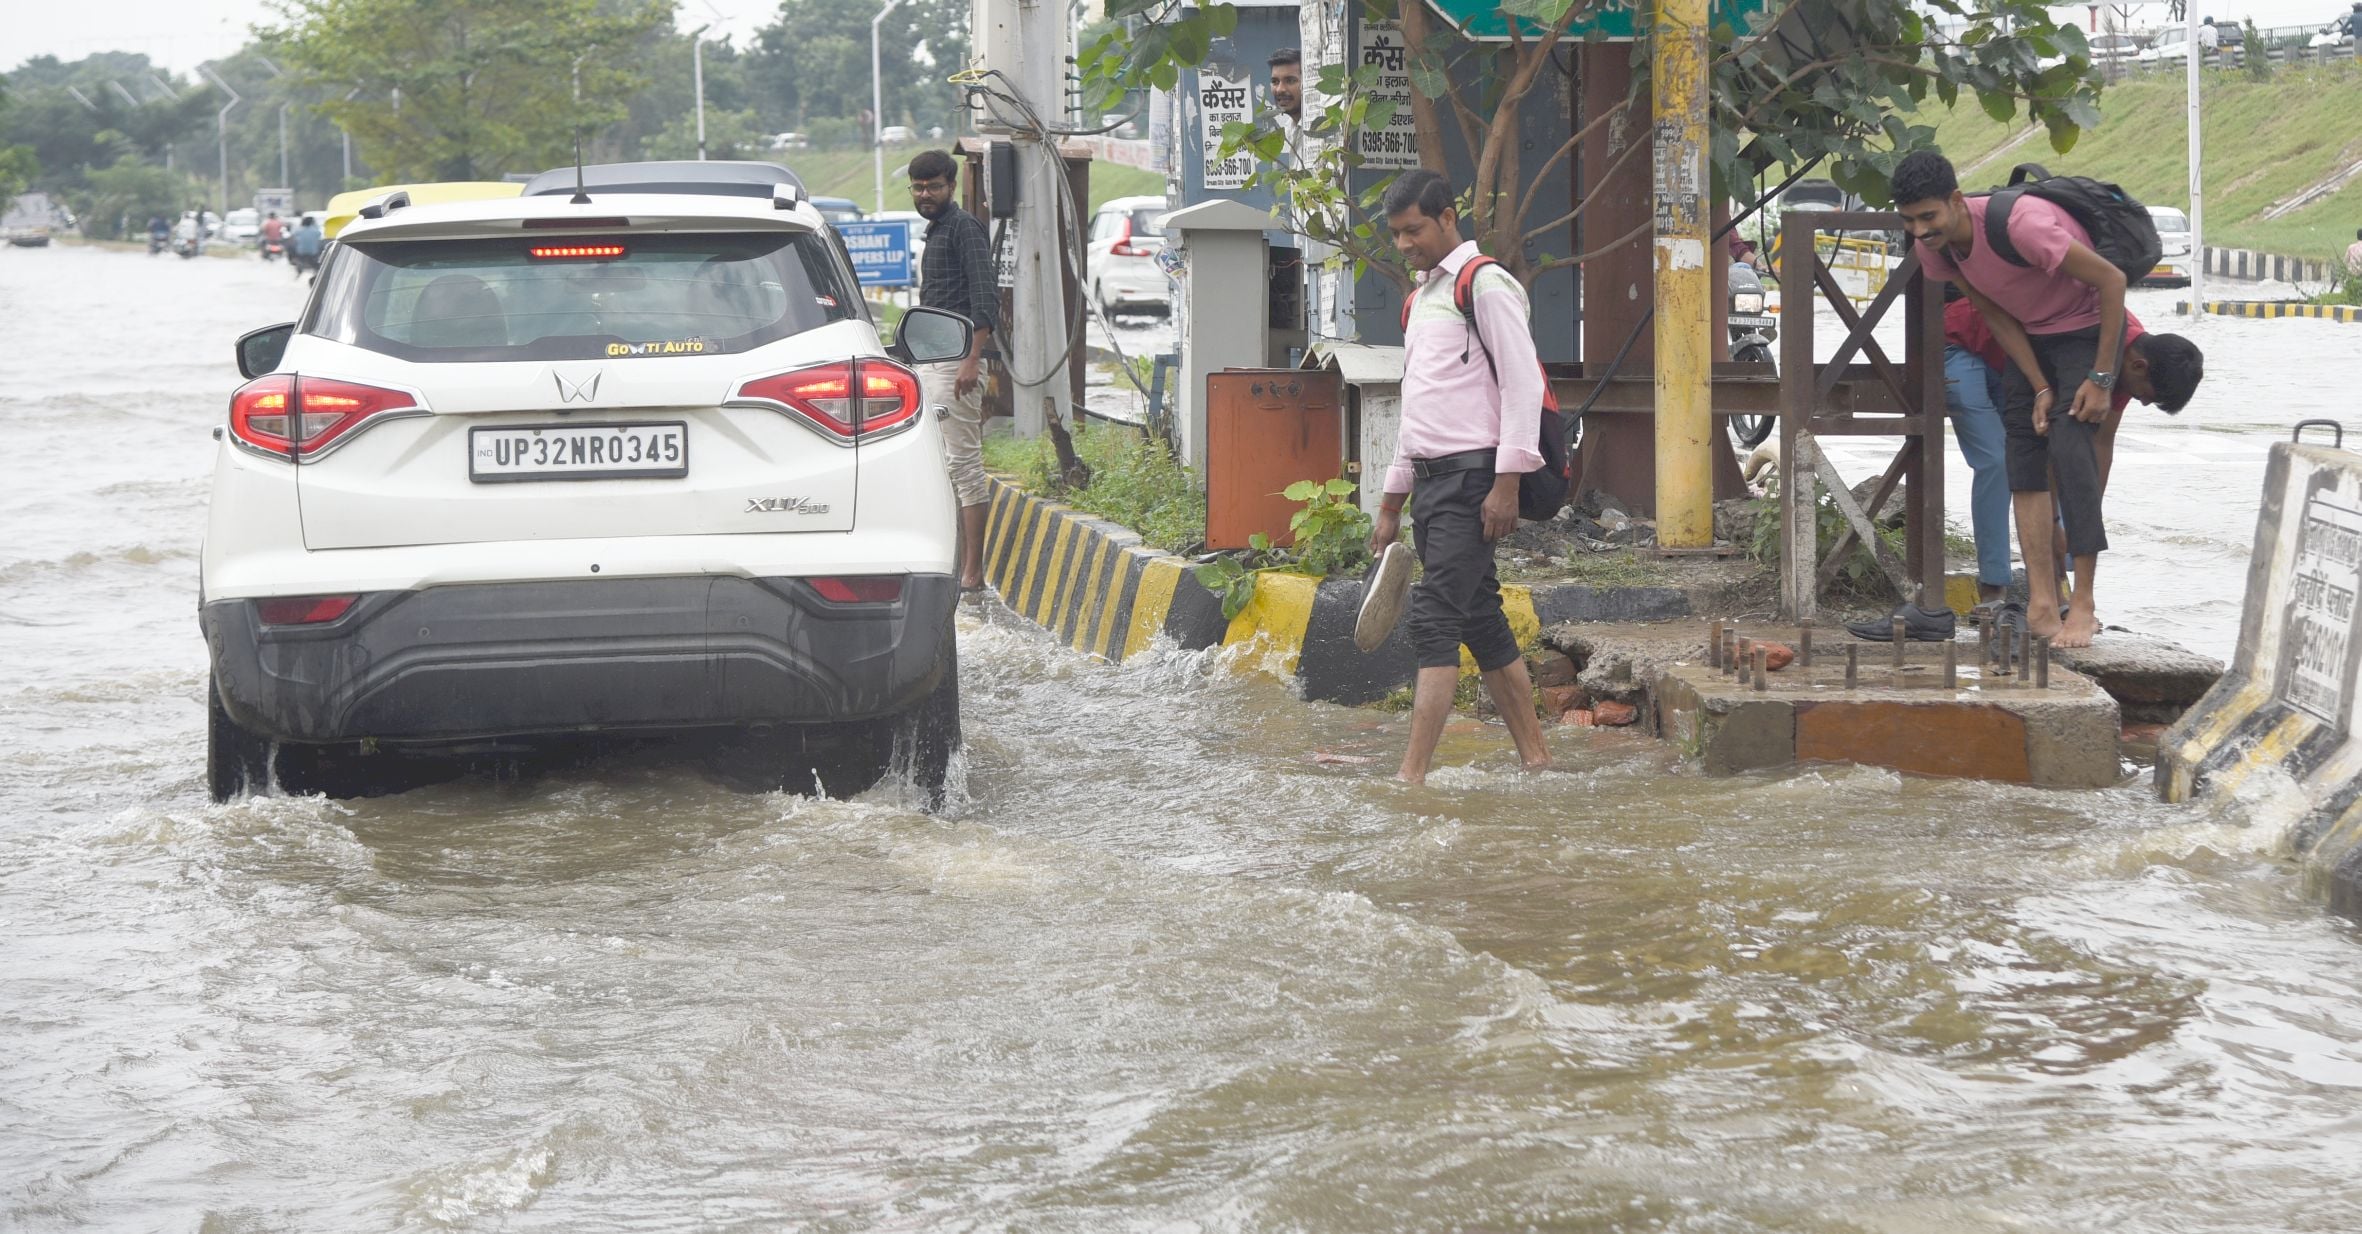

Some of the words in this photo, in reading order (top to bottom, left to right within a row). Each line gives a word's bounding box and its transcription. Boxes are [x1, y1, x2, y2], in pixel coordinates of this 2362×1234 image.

[1363, 35, 1406, 71] कैंस
[1201, 80, 1246, 108] कैंसर
[1208, 112, 1219, 122] का
[1220, 112, 1242, 122] इलाज
[1362, 131, 1417, 153] 6395-566-700
[477, 449, 493, 458] IND
[495, 434, 679, 465] UP32NR0345
